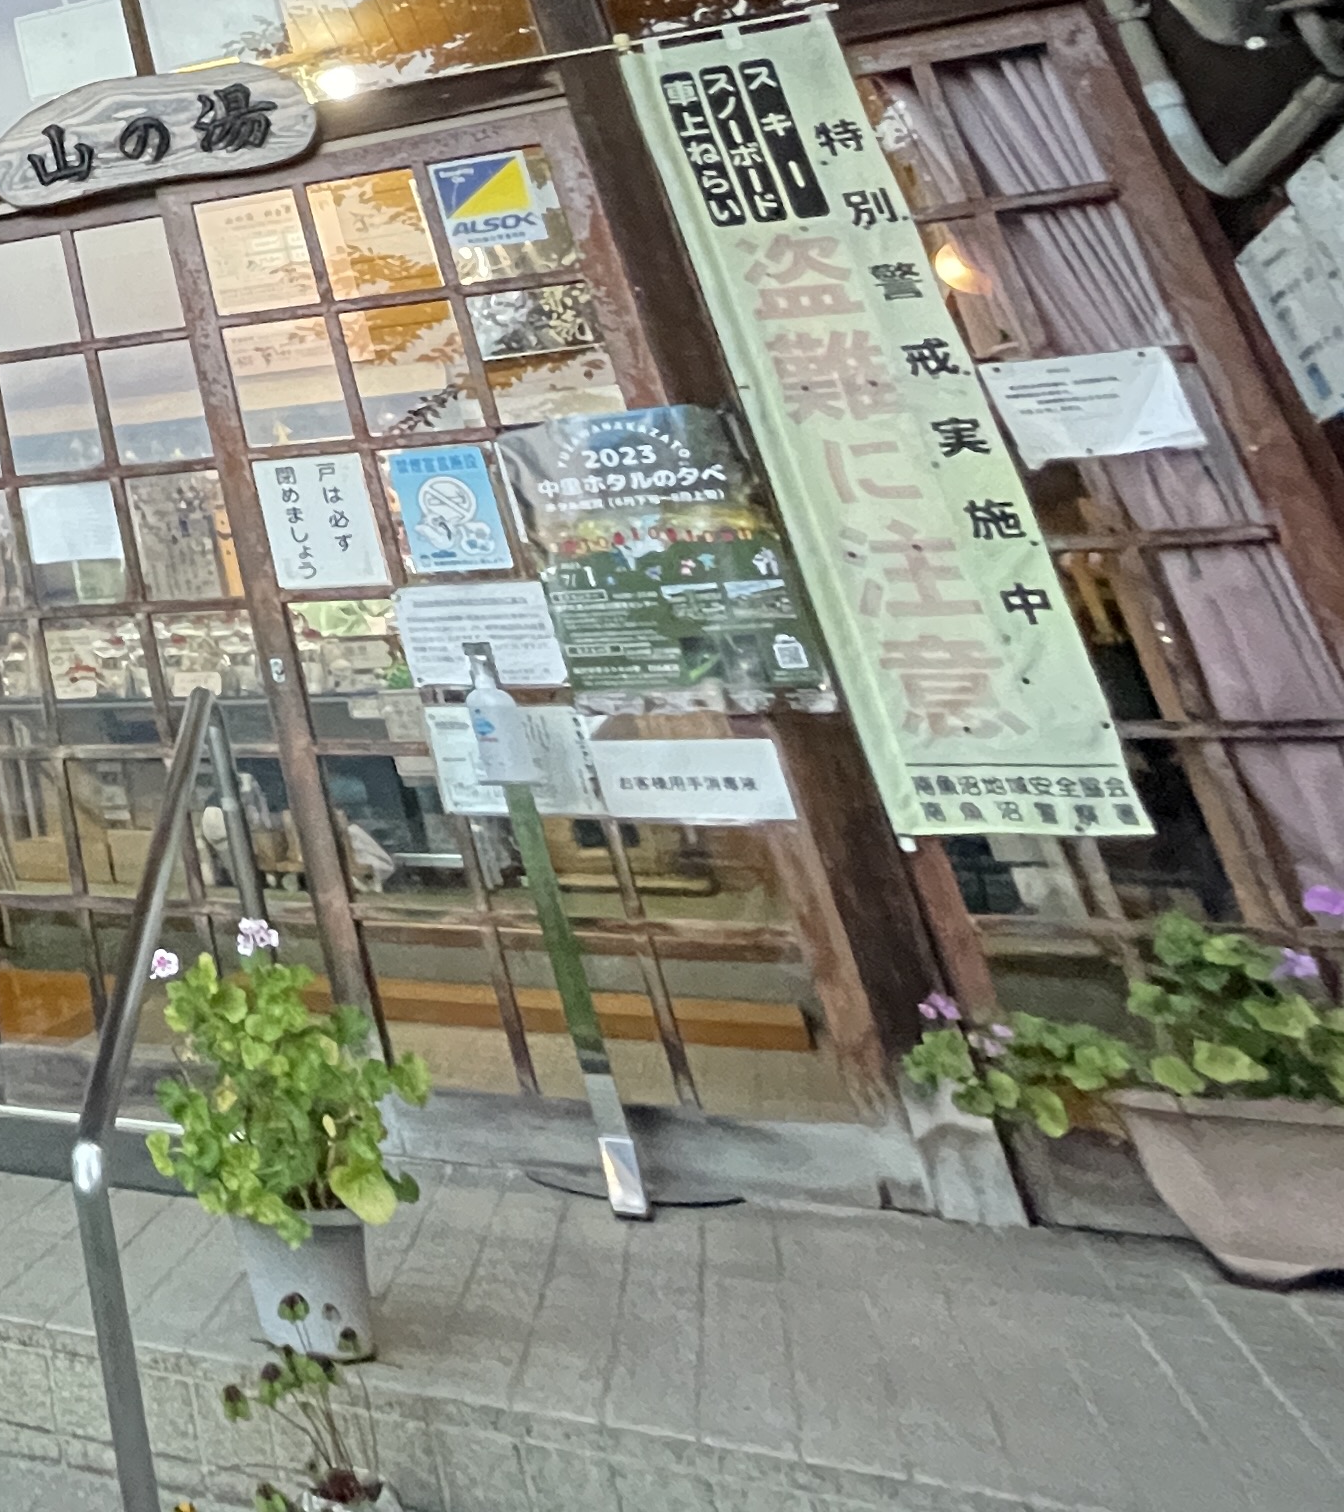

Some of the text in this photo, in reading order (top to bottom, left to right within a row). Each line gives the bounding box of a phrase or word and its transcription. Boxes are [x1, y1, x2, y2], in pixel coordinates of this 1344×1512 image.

[27, 83, 278, 186] 山の湯
[663, 80, 742, 221] 車上ねらい
[703, 72, 777, 217] スノーボード
[743, 66, 806, 188] スキー
[452, 212, 538, 237] ALSOK
[814, 118, 1052, 626] 特別警戒実施中
[316, 462, 352, 552] 戸は必ず
[581, 444, 657, 469] 2023
[734, 233, 1032, 736] 盗難に注意
[275, 466, 317, 580] 閉めましょう
